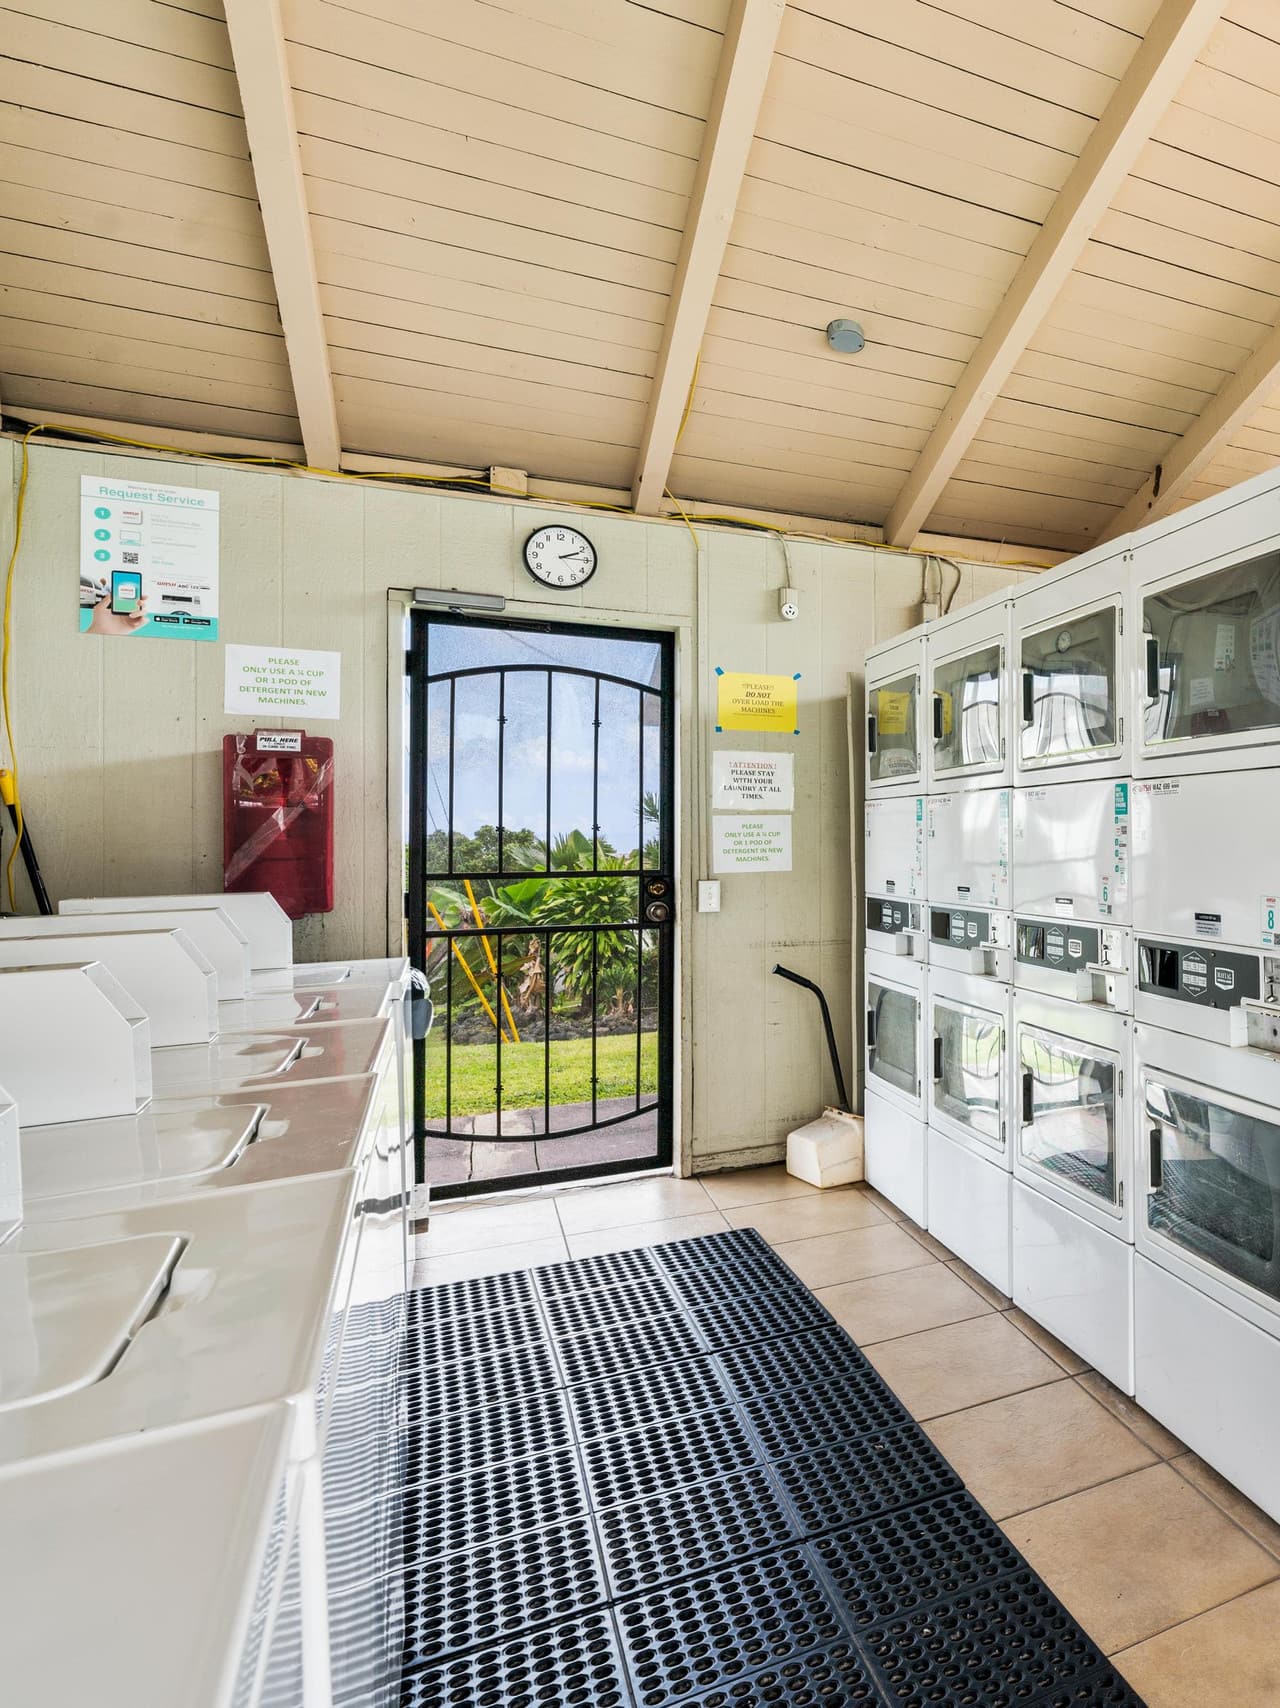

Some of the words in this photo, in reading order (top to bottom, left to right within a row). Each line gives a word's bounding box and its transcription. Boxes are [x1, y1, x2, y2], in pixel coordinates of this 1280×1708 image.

[99, 486, 153, 501] Request
[157, 493, 206, 507] Service
[557, 533, 565, 541] 12
[532, 551, 538, 559] 9
[536, 562, 542, 570] 8
[570, 573, 576, 581] 5
[268, 657, 300, 666] PLEASE
[242, 666, 267, 674] ONLY
[269, 667, 287, 675] USE
[255, 676, 268, 684] OR
[278, 677, 298, 686] POD
[239, 685, 292, 694] DETERGENT
[306, 689, 328, 697] NEW
[741, 706, 776, 714] MACHINES
[1267, 910, 1275, 930] 8
